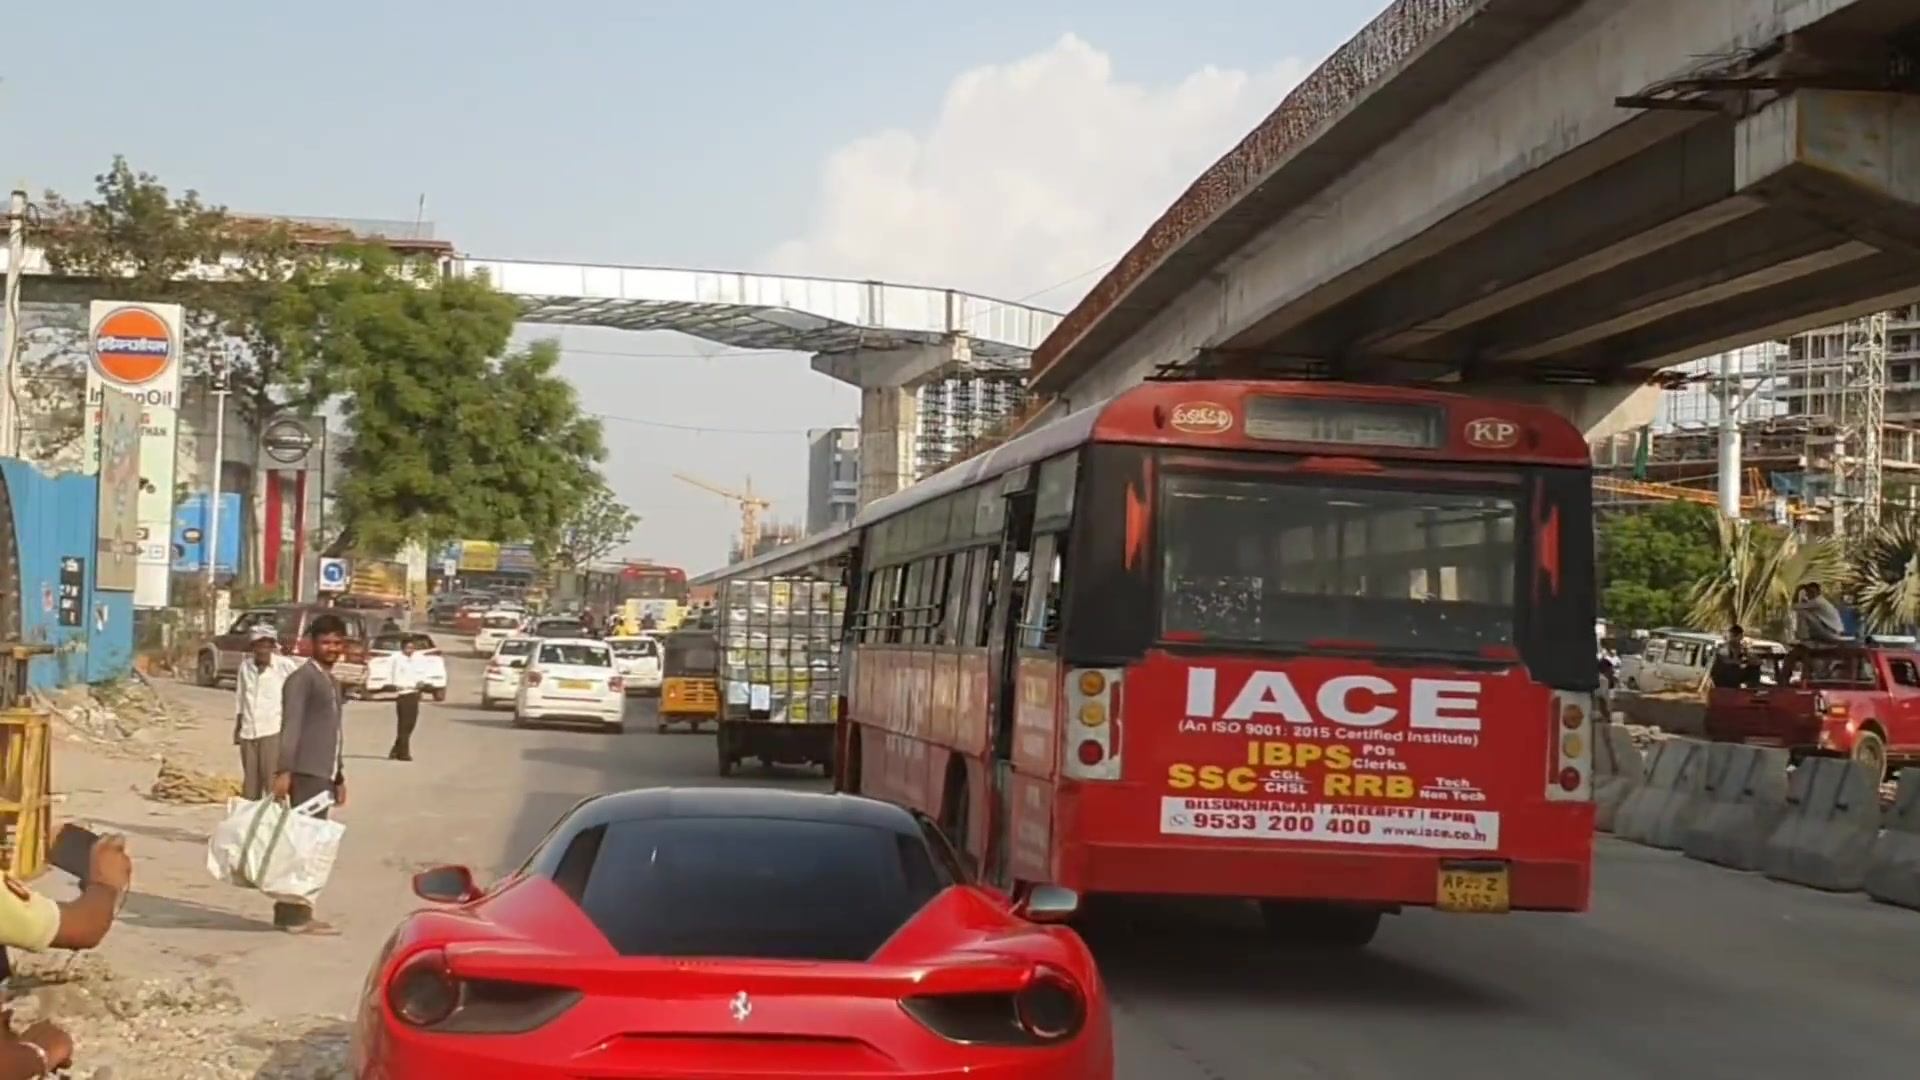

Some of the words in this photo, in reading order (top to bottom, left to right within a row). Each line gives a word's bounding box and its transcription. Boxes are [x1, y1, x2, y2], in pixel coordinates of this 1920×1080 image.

[1474, 423, 1515, 441] KP
[1186, 666, 1481, 731] IACE
[1178, 719, 1206, 733] (An
[1212, 721, 1241, 734] ISO
[1293, 725, 1331, 739] 2015
[1335, 727, 1403, 743] Certified
[1407, 731, 1479, 748] Institute)
[1248, 740, 1352, 770] IBPS
[1362, 743, 1396, 756] POs
[1352, 757, 1407, 771] Clerks
[1168, 763, 1258, 792] SSC
[1269, 769, 1305, 780] CGL
[1435, 776, 1470, 788] Tech
[1264, 781, 1309, 795] CHSL
[1323, 772, 1415, 798] RRB
[1419, 789, 1448, 801] Non
[1452, 790, 1486, 802] Tech
[1194, 812, 1257, 830] 9533
[1267, 815, 1315, 833] 200
[1325, 818, 1372, 835] 400
